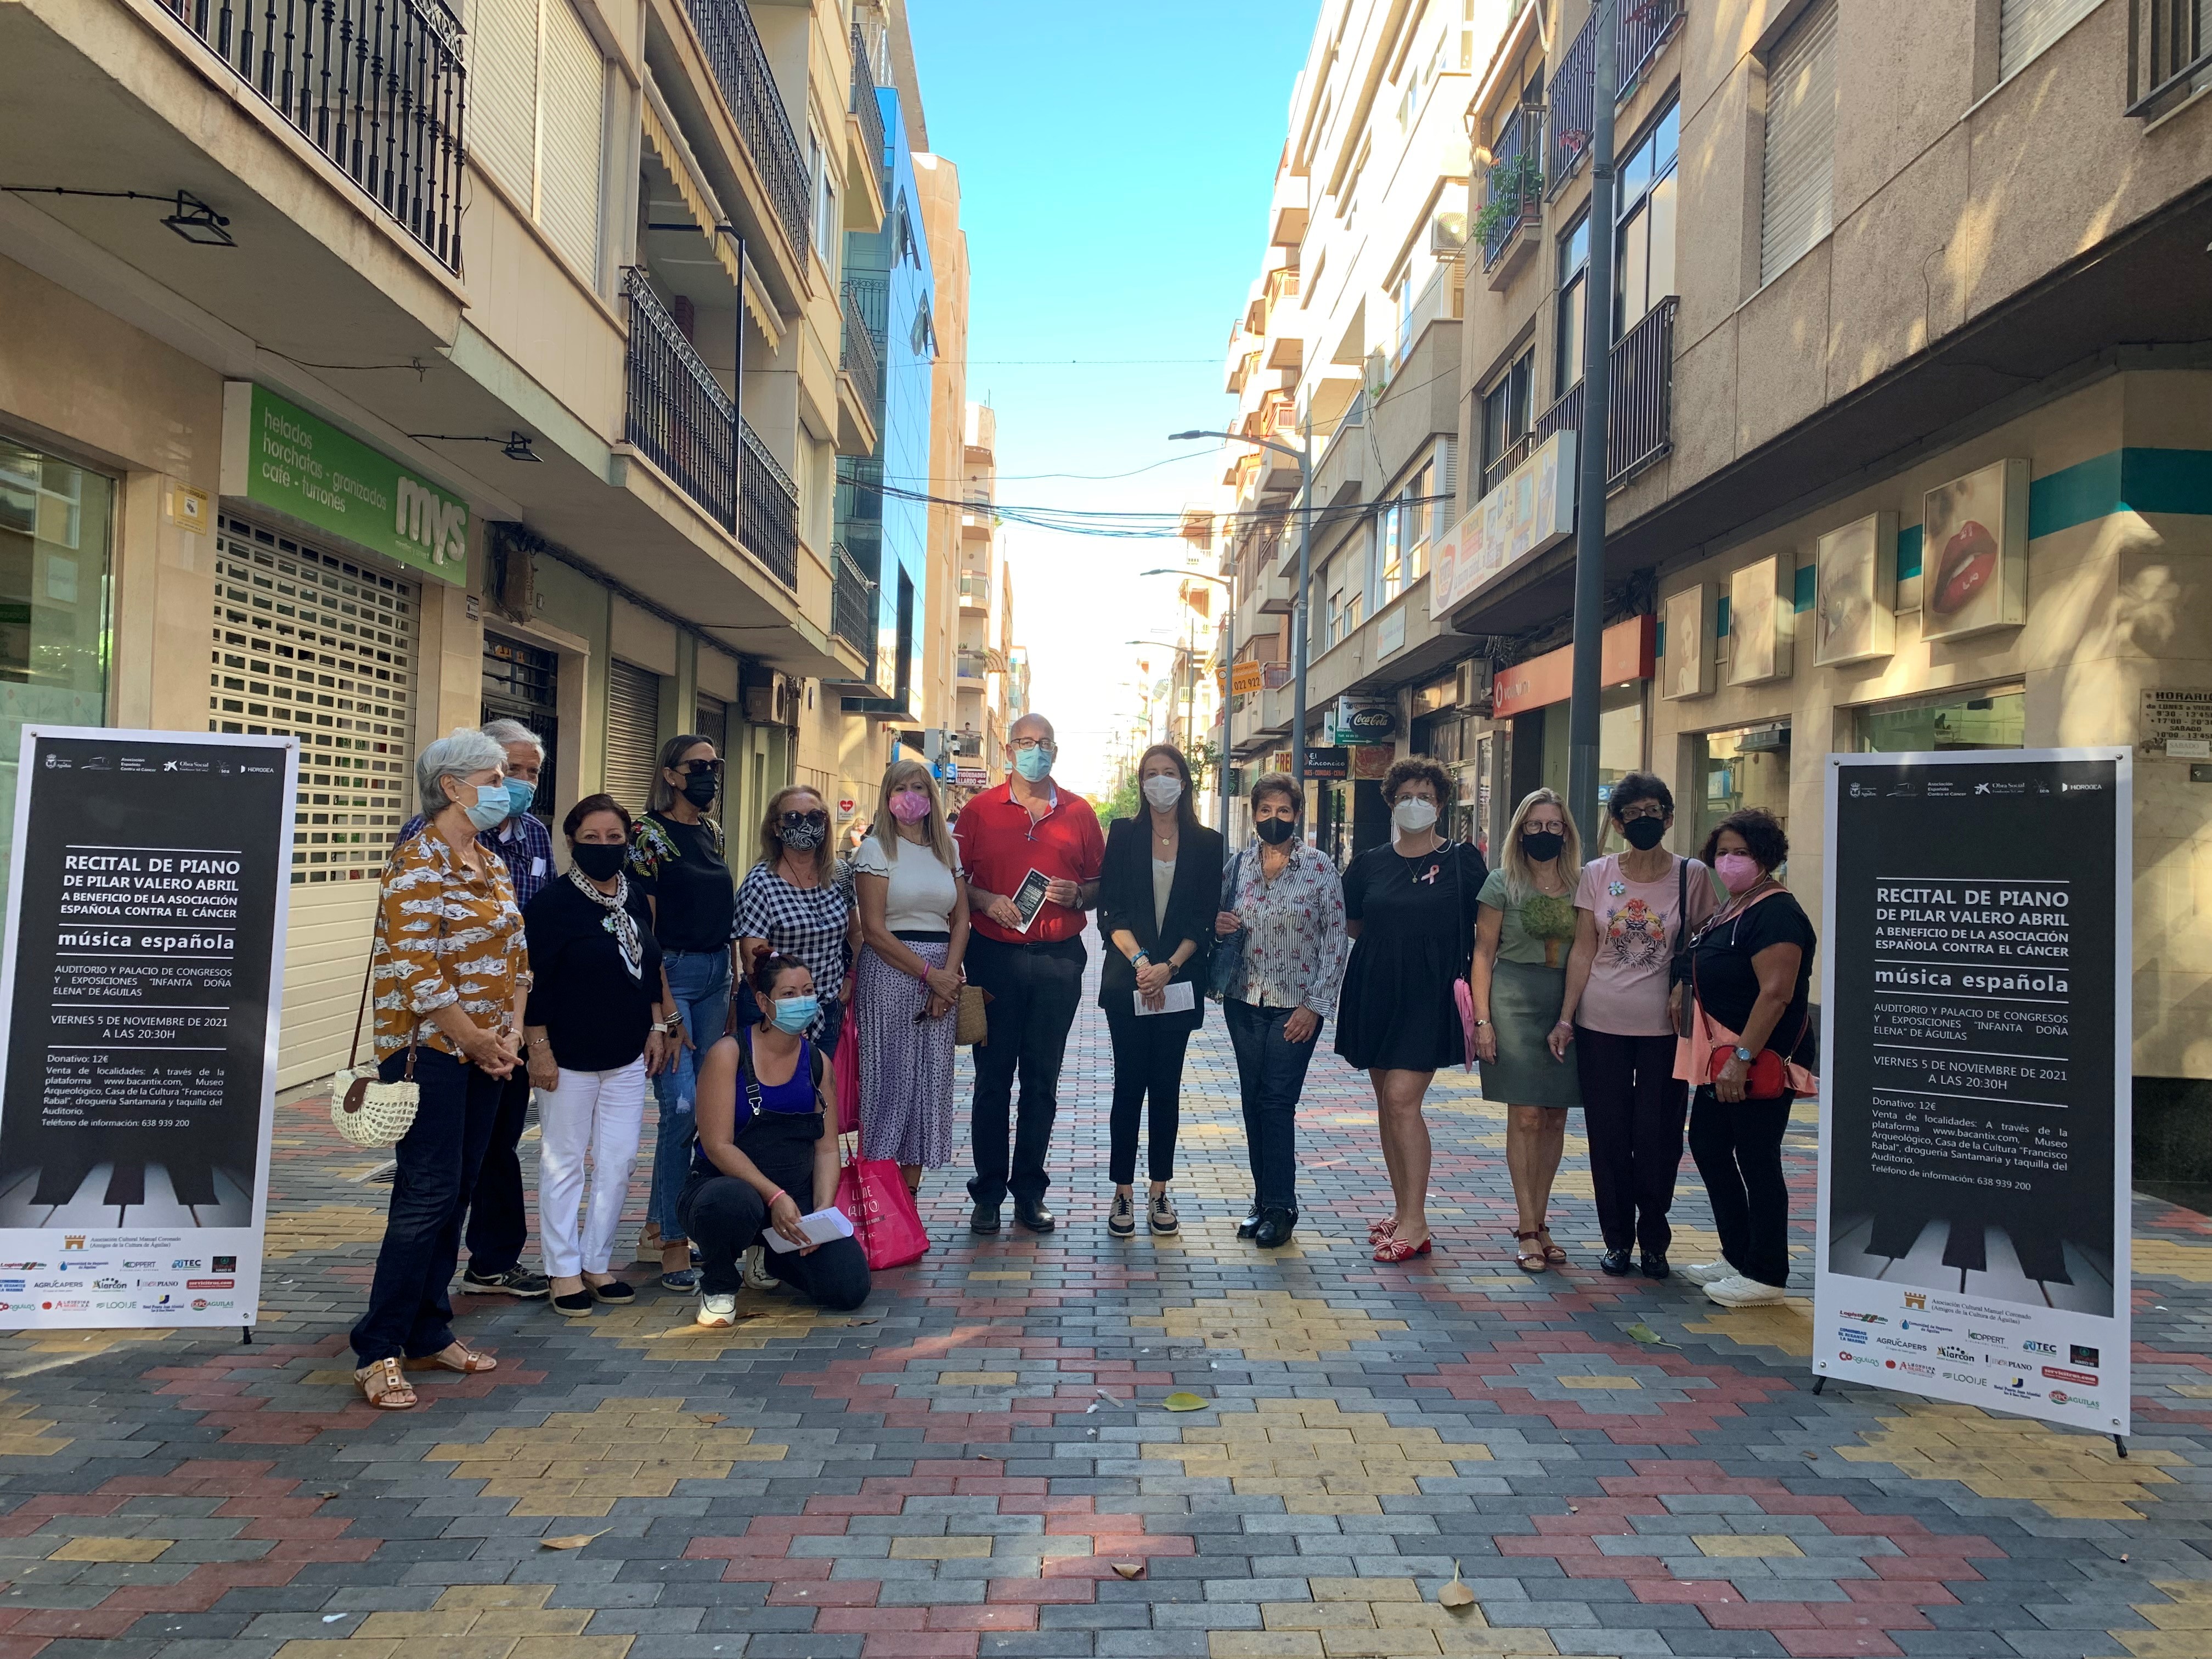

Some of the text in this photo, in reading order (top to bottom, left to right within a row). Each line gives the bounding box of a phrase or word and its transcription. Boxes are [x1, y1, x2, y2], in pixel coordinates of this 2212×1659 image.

[264, 407, 312, 450] helados
[263, 431, 386, 510] horchatas granizados
[262, 462, 345, 512] café turrones
[396, 476, 466, 565] mys
[1234, 680, 1246, 691] 022
[1248, 676, 1261, 688] 922
[65, 855, 240, 874] RECITAL DE PIANO
[63, 874, 239, 891] DE PILAR VALERO ABRIL
[61, 891, 238, 906] A BENEFICIO DE LA ASOCIACIÓN
[1877, 888, 2069, 907] RECITAL DE PIANO
[60, 903, 237, 918] ESPAÑOLA CONTRA EL CÁNCER
[1876, 909, 2069, 927] DE PILAR VALERO ABRIL
[58, 930, 234, 952] música española
[1875, 926, 2069, 943] A BENEFICIO DE LA ASOCIACIÓN
[1876, 939, 2069, 957] ESPAÑOLA CONTRA EL CÁNCER
[1875, 967, 2068, 993] música española
[50, 1015, 228, 1027] VIERNES 5 DE NOVIEMBRE DE 2021
[1874, 1003, 2068, 1024] AUDITORIO Y PALACIO DE CONGRESOS
[102, 1029, 175, 1039] A LAS 20:30H
[1874, 1014, 2068, 1036] Y EXPOSICIONES "INFANTA DOÑA
[1874, 1026, 1967, 1041] ELENA" DE ÁGUILAS
[1874, 1056, 2067, 1081] VIERNES 5 DE NOVIEMBRE DE 2021
[1928, 1074, 2007, 1090] A LAS 20:30H
[1873, 1097, 1936, 1111] Donativo: 12€
[1872, 1109, 2068, 1137] Venta de localidades: A través de la
[1872, 1120, 2068, 1148] plataforma www.bacantix.com, Museo
[1872, 1131, 2068, 1159] Arqueológico, Casa de la Cultura "Francisco
[1871, 1152, 1914, 1164] Auditorio.
[1872, 1141, 2067, 1171] Rabal", droguería Santamaría y taquilla del
[1871, 1164, 2031, 1190] Teléfono de información: 638 939 200
[1932, 1299, 1960, 1308] Asociación
[1962, 1304, 1983, 1312] Cultural
[2005, 1311, 2032, 1320] Coronado
[1876, 1337, 1927, 1351] AGRUCAPERS
